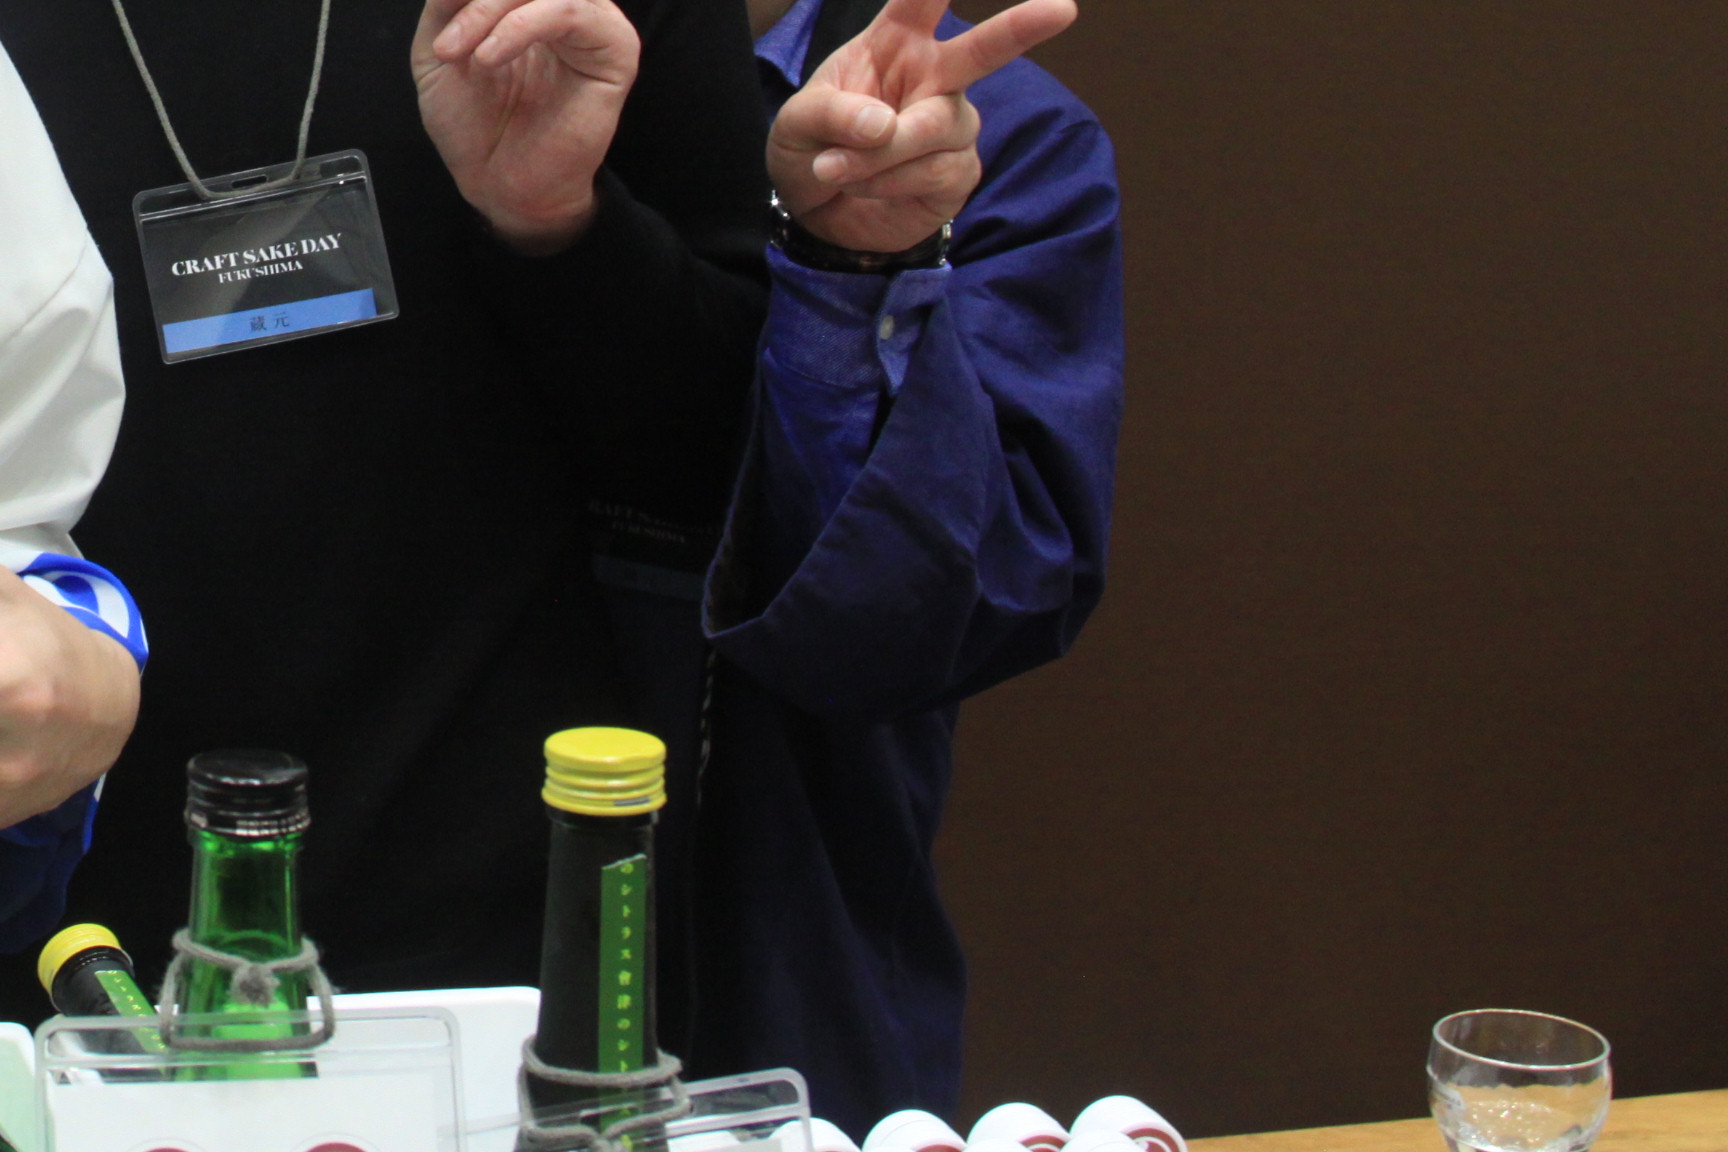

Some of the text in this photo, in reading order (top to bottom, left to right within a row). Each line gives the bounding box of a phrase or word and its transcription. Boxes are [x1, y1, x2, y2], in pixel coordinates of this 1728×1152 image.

[171, 233, 342, 277] CRAFT SAKE DAY
[218, 260, 303, 284] FUKUSHIMA
[248, 312, 290, 333] 蔵元
